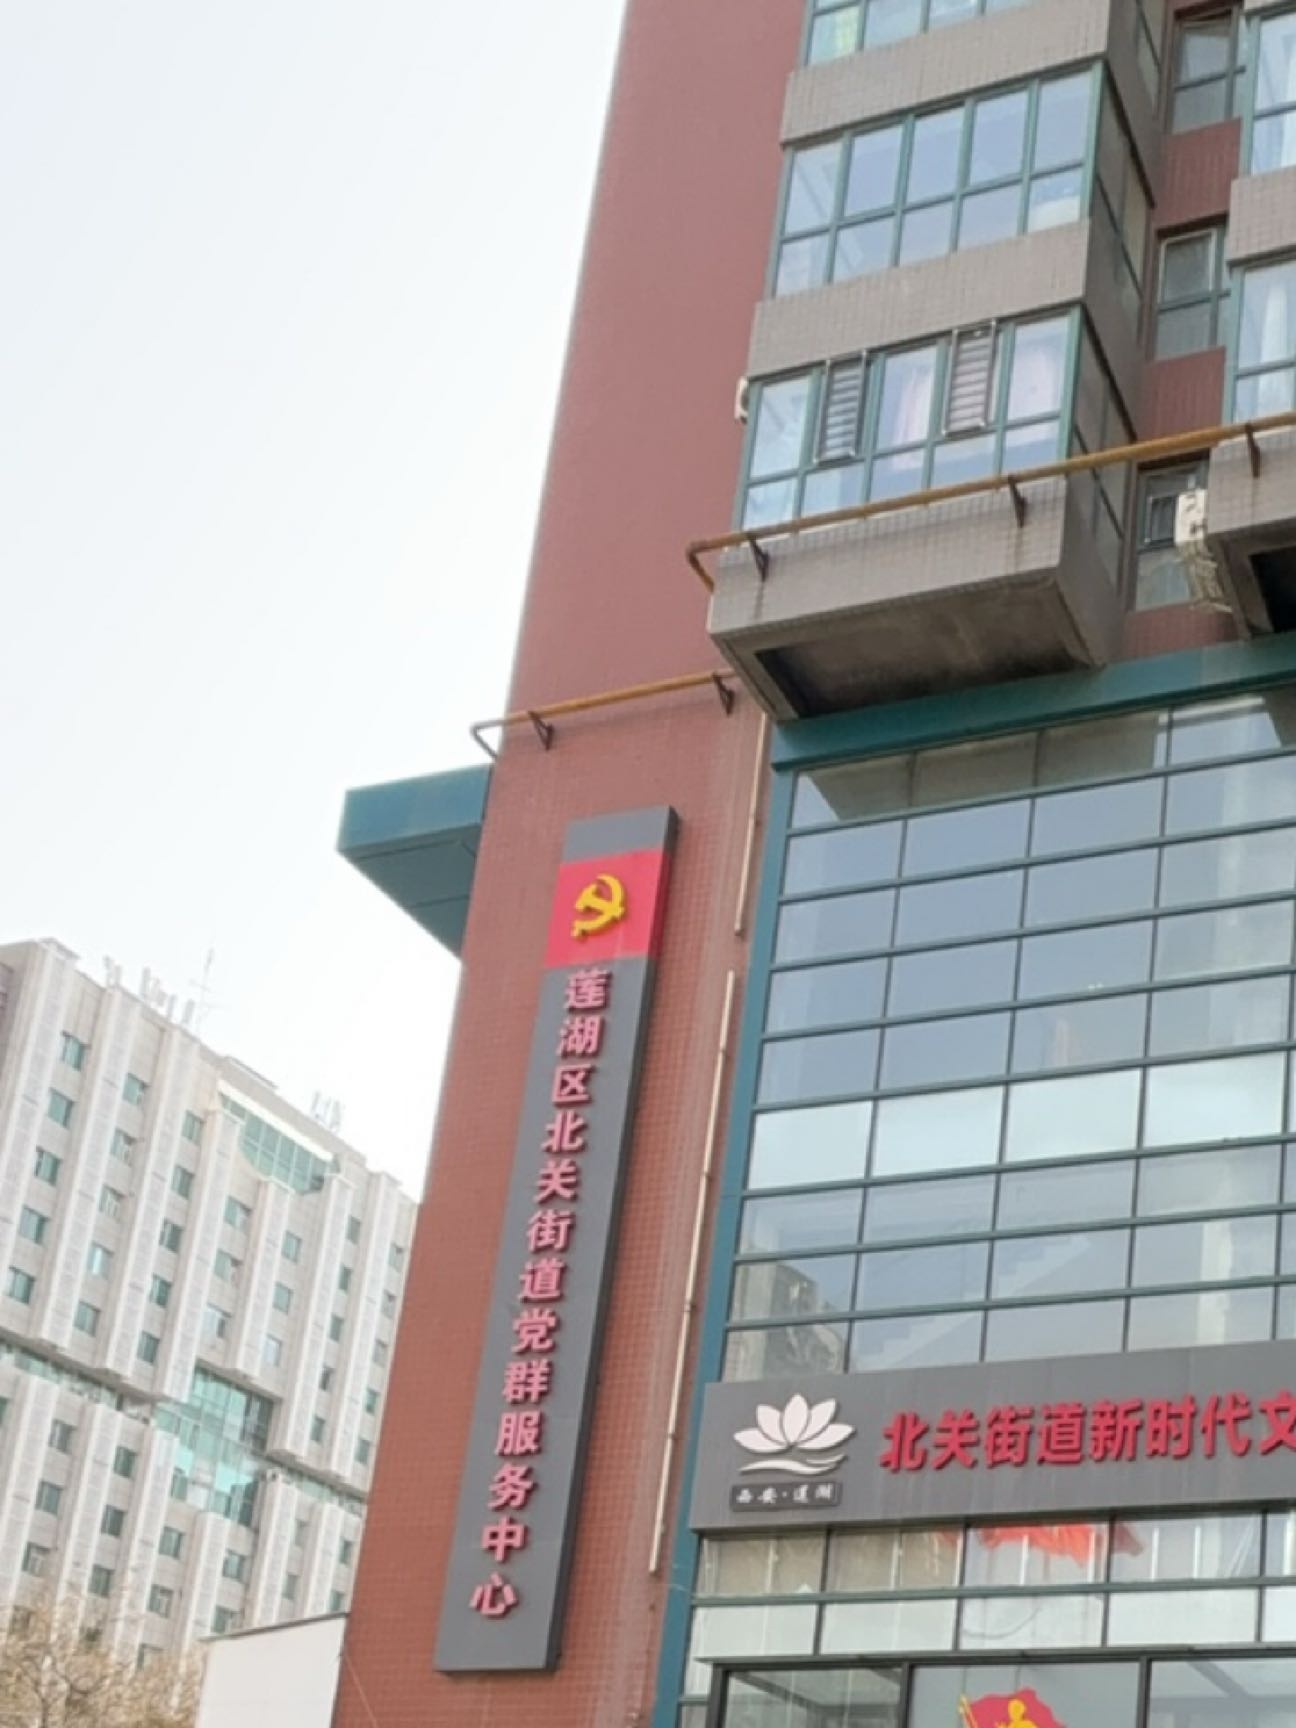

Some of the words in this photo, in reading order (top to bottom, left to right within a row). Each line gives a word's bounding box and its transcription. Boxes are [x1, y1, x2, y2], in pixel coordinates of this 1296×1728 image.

[469, 966, 611, 1620] 莲湖区北关街道党群服务中心
